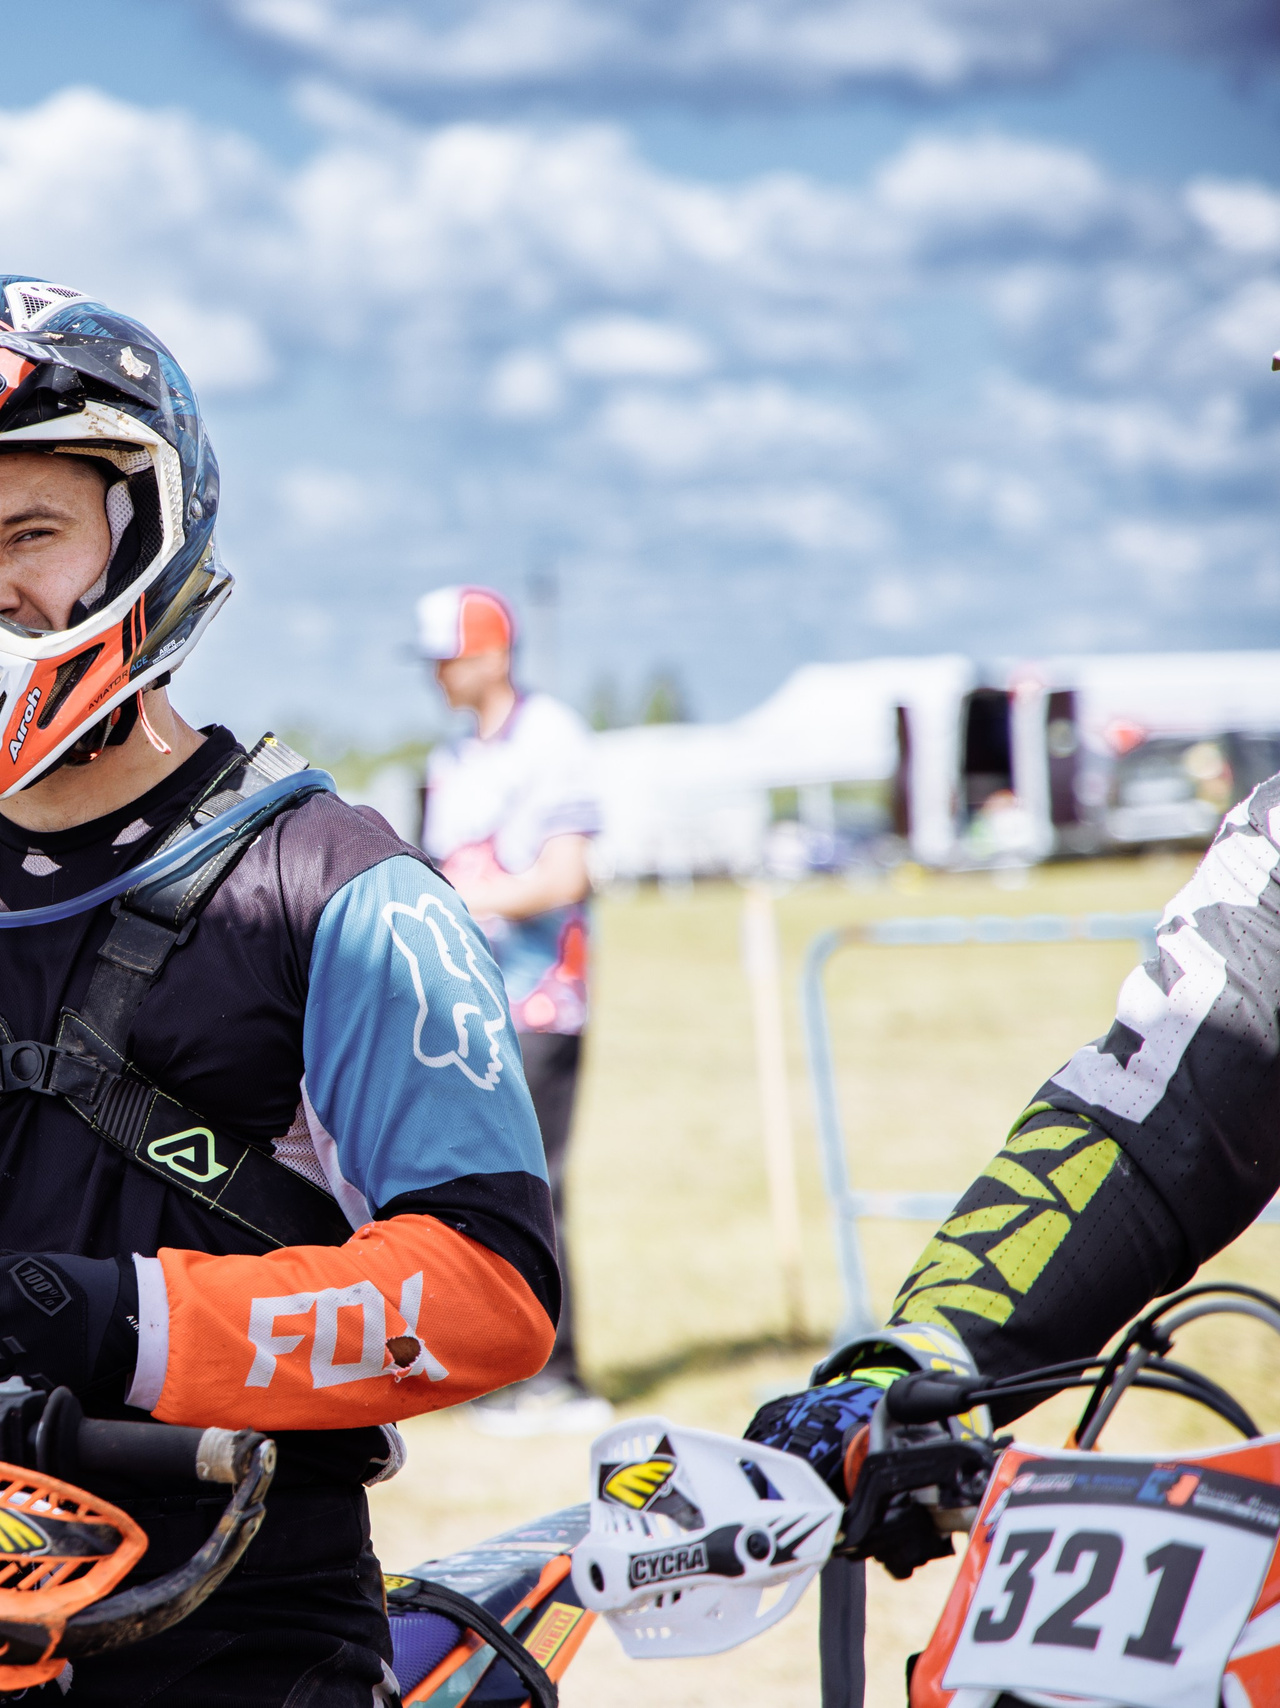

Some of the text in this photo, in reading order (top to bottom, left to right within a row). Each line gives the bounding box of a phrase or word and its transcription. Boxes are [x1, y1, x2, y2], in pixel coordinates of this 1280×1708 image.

[8, 686, 42, 765] Airoh
[19, 1265, 64, 1308] 100%
[244, 1270, 450, 1390] FOX
[629, 1541, 709, 1585] CYCRA
[973, 1529, 1206, 1667] 321
